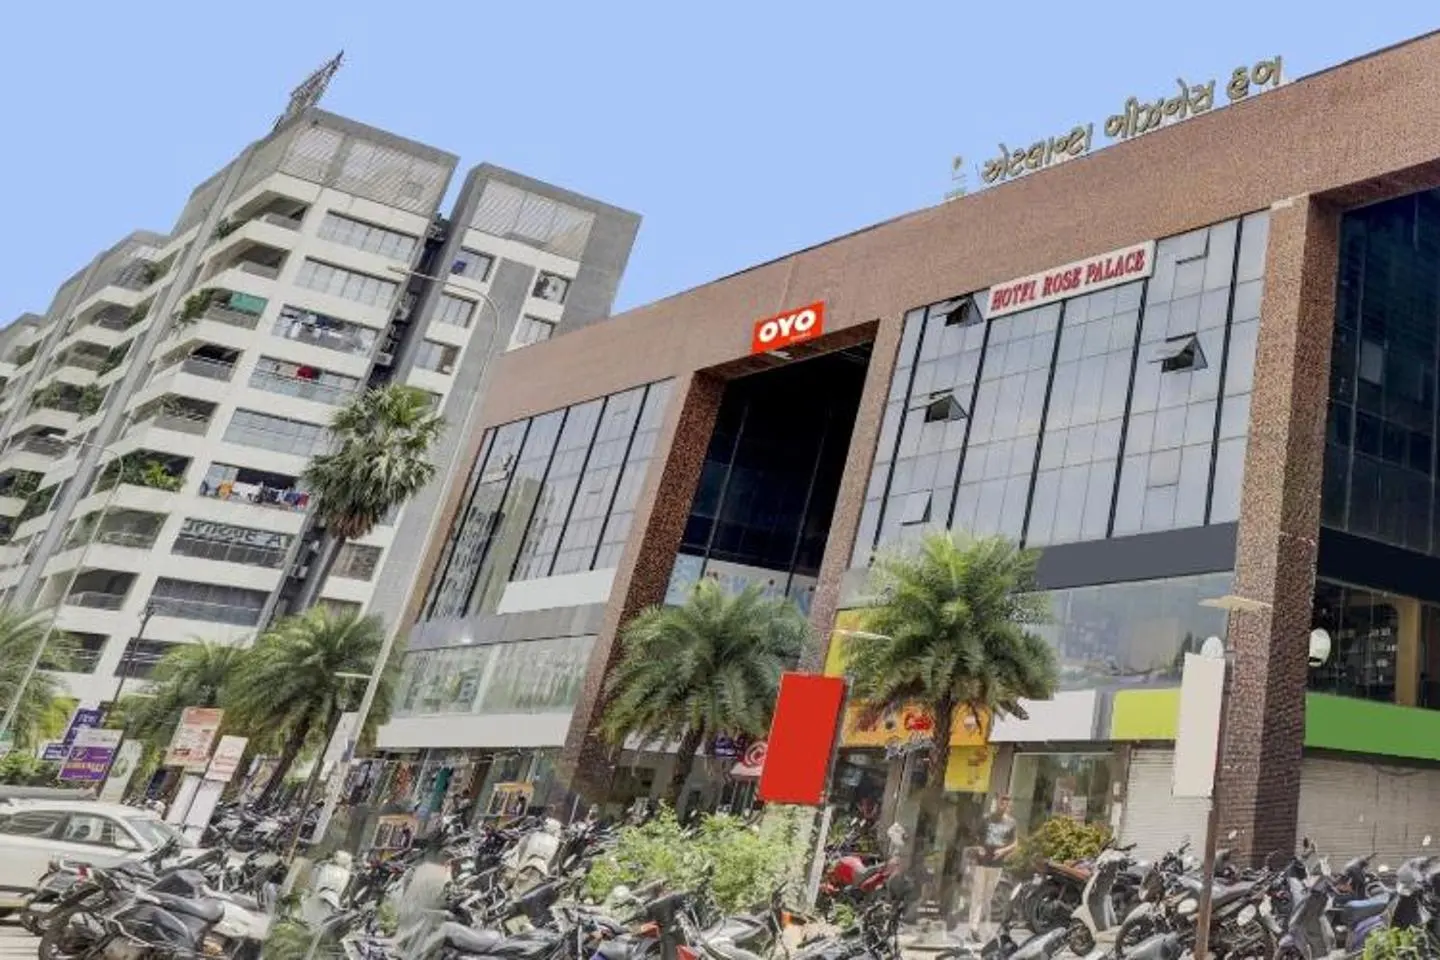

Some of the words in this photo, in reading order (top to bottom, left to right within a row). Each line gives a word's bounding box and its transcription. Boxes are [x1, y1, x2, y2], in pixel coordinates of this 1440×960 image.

[991, 280, 1036, 309] HOTEL
[1042, 267, 1082, 297] ROSE
[1085, 249, 1145, 284] PALACE
[759, 310, 816, 342] OYO
